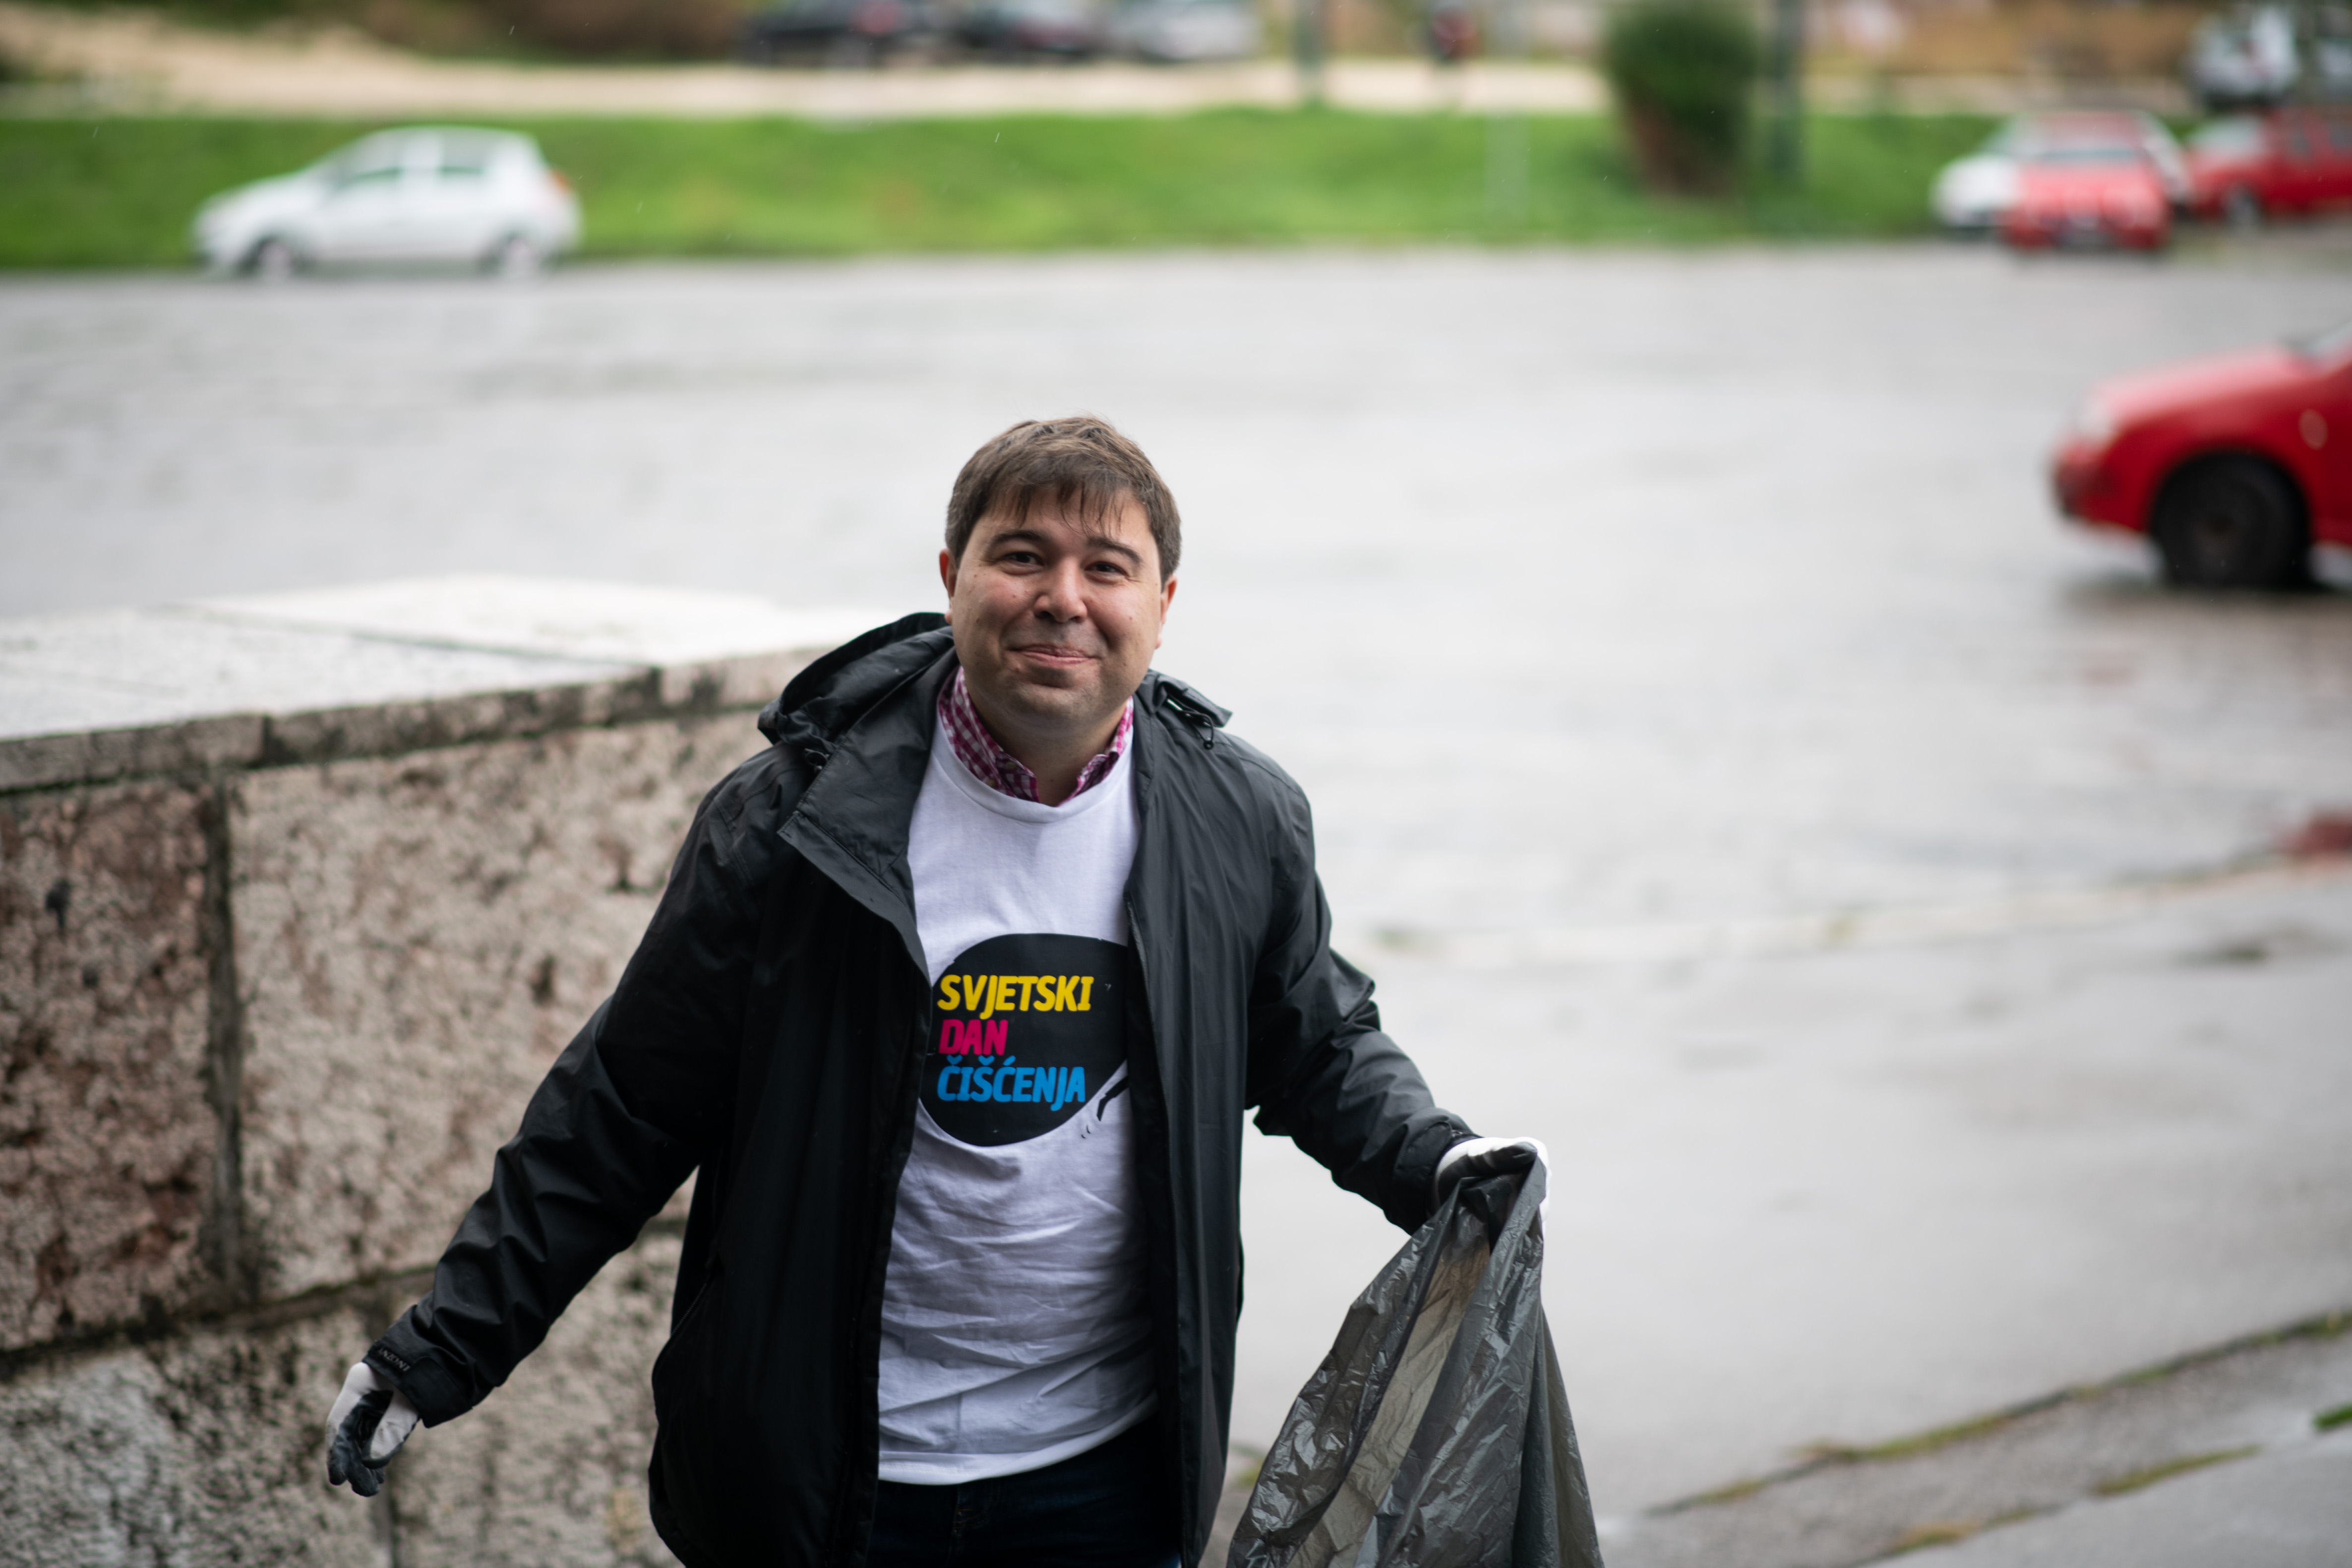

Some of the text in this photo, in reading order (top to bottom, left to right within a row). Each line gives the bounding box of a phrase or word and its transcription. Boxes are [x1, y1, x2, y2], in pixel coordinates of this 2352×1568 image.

[937, 974, 1094, 1020] SVJETSKI
[939, 1019, 1009, 1056] DAN
[937, 1055, 1086, 1112] ČIŠĆENJA
